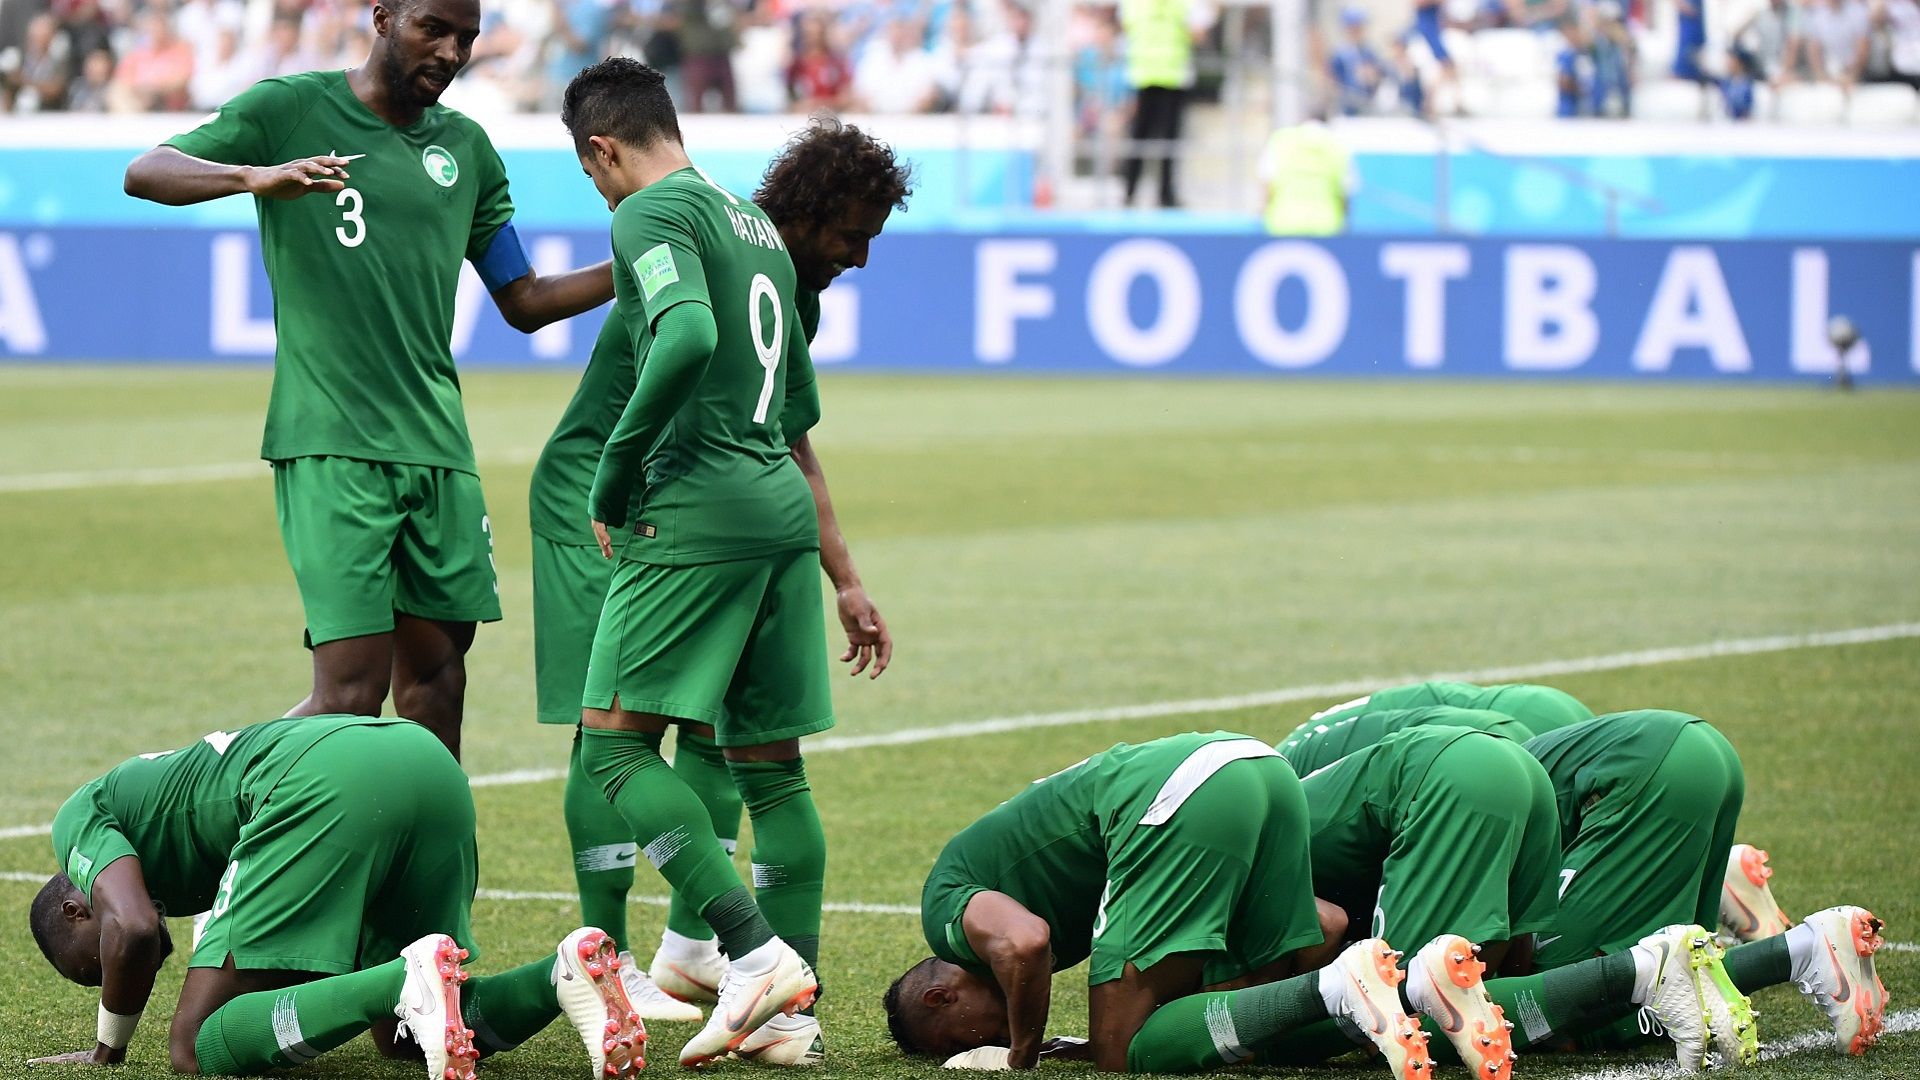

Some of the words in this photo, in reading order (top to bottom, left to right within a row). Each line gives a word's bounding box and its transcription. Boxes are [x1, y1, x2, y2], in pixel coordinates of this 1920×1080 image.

[336, 188, 366, 247] 3
[723, 204, 784, 251] HATAN
[749, 273, 783, 424] 9
[974, 237, 1920, 376] FOOTBAL
